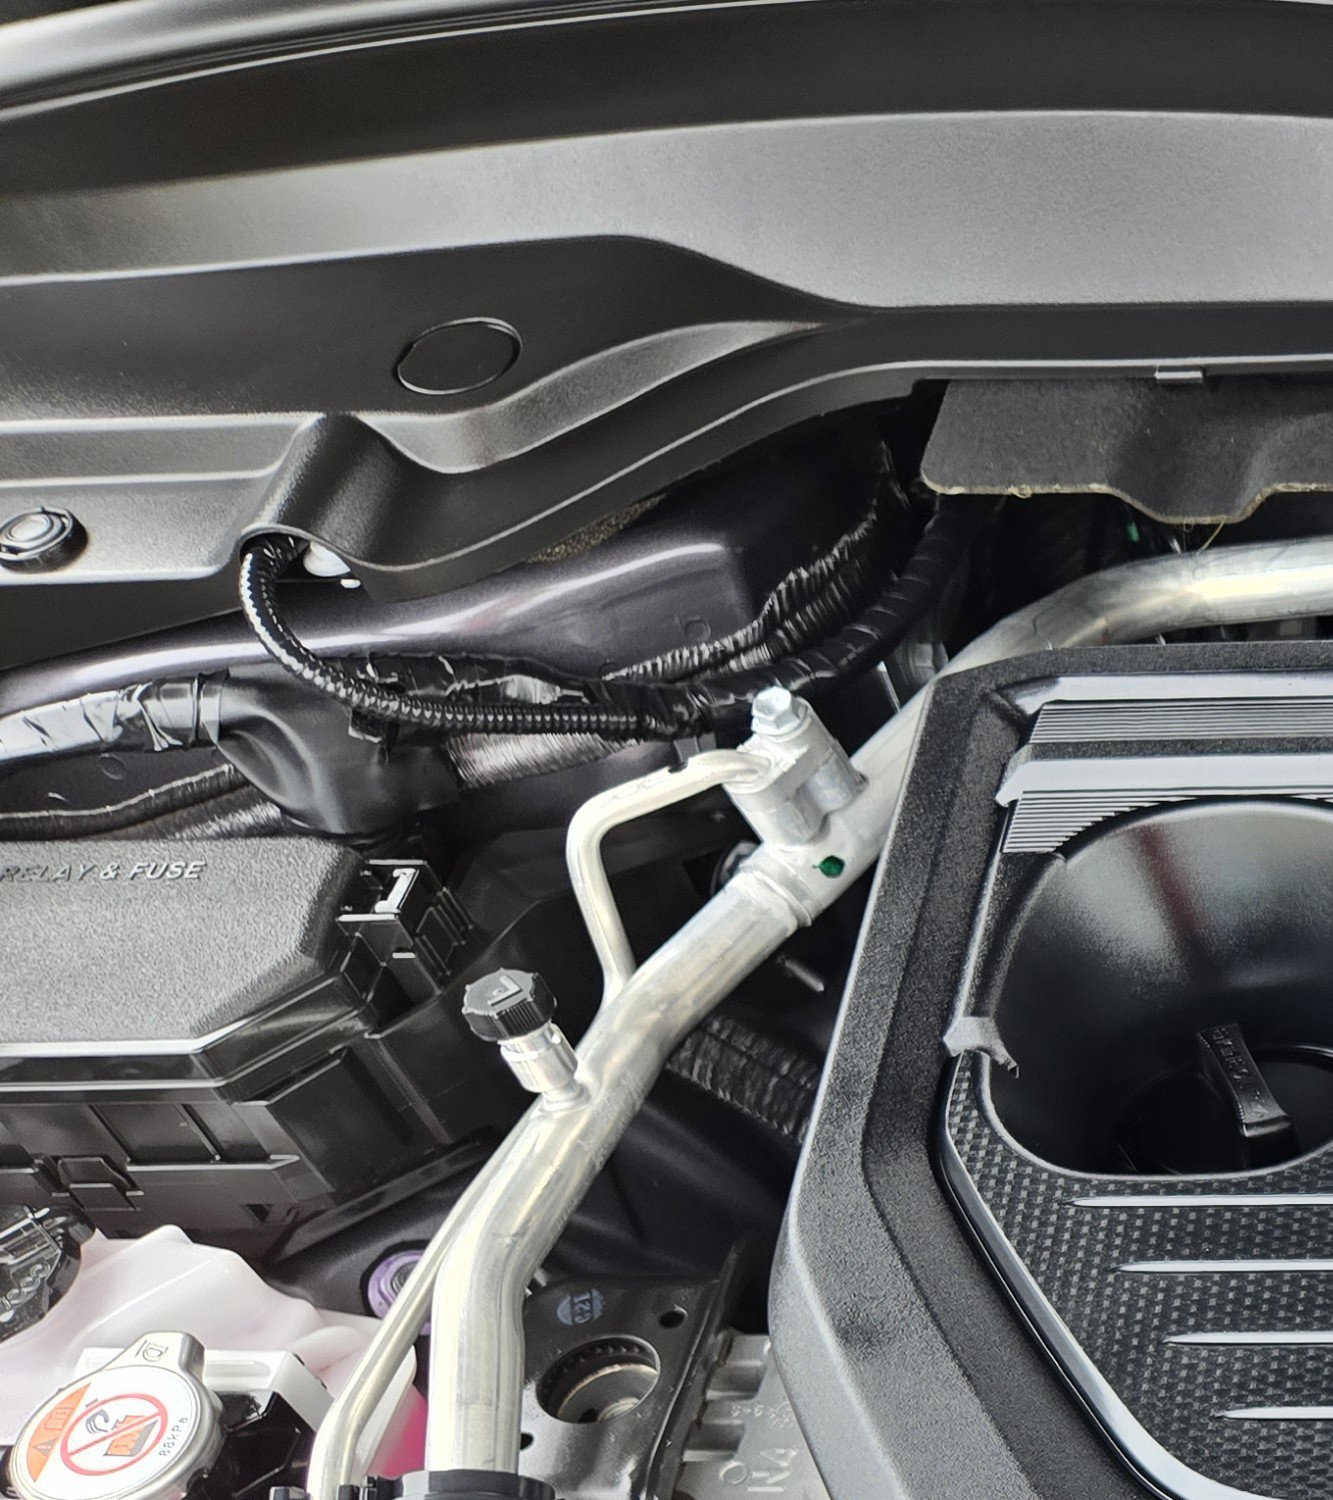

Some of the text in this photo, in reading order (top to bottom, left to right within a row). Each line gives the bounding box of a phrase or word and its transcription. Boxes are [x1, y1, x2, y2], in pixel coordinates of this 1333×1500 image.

[0, 860, 206, 882] RELAY & FUSE
